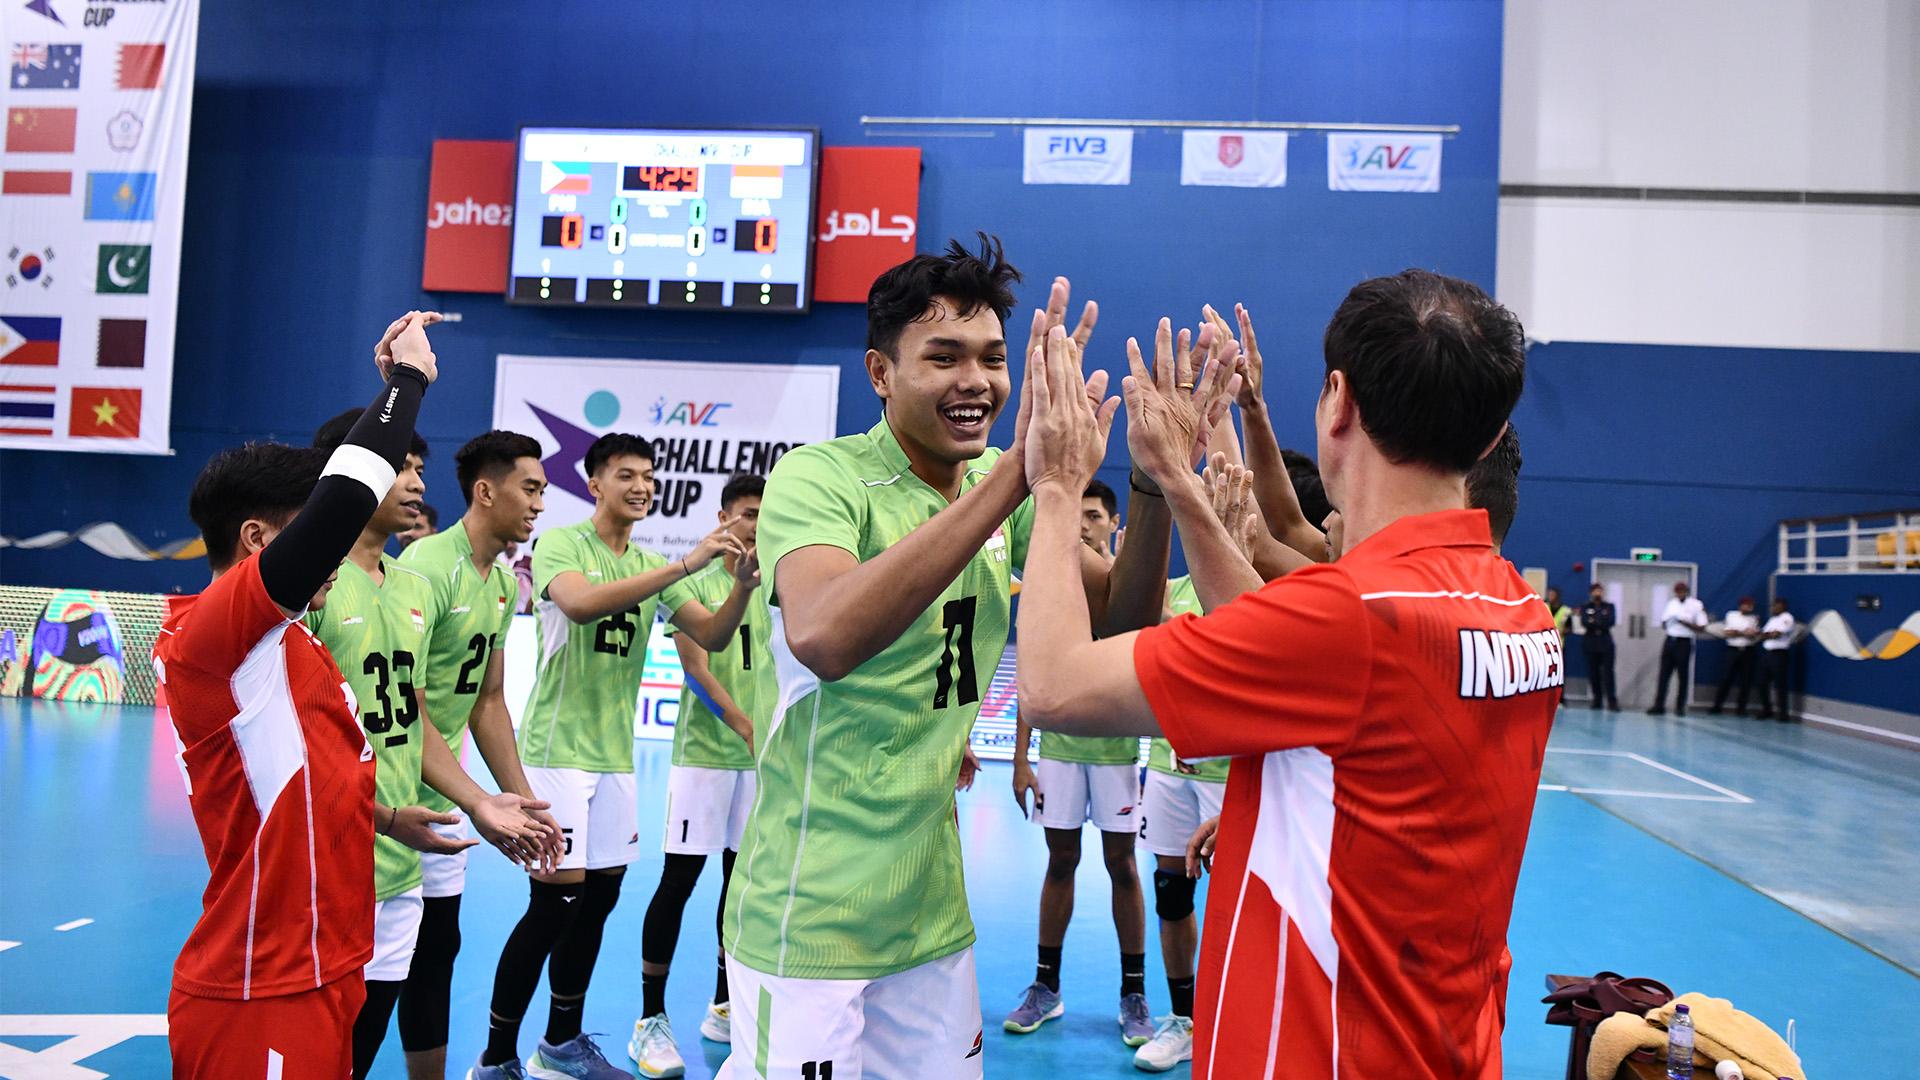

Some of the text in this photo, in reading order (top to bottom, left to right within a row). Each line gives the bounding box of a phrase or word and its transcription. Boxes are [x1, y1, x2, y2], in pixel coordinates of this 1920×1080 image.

[83, 7, 115, 27] CUP
[1049, 136, 1106, 154] FIVB
[1361, 145, 1430, 170] AVC
[561, 214, 584, 250] 0
[755, 219, 778, 254] 0
[820, 207, 915, 243] جاهز
[664, 401, 733, 426] AVC
[652, 437, 805, 476] CHALLENG
[647, 479, 703, 518] CUP
[740, 624, 752, 670] 1
[363, 650, 419, 734] 33
[682, 819, 689, 843] 1
